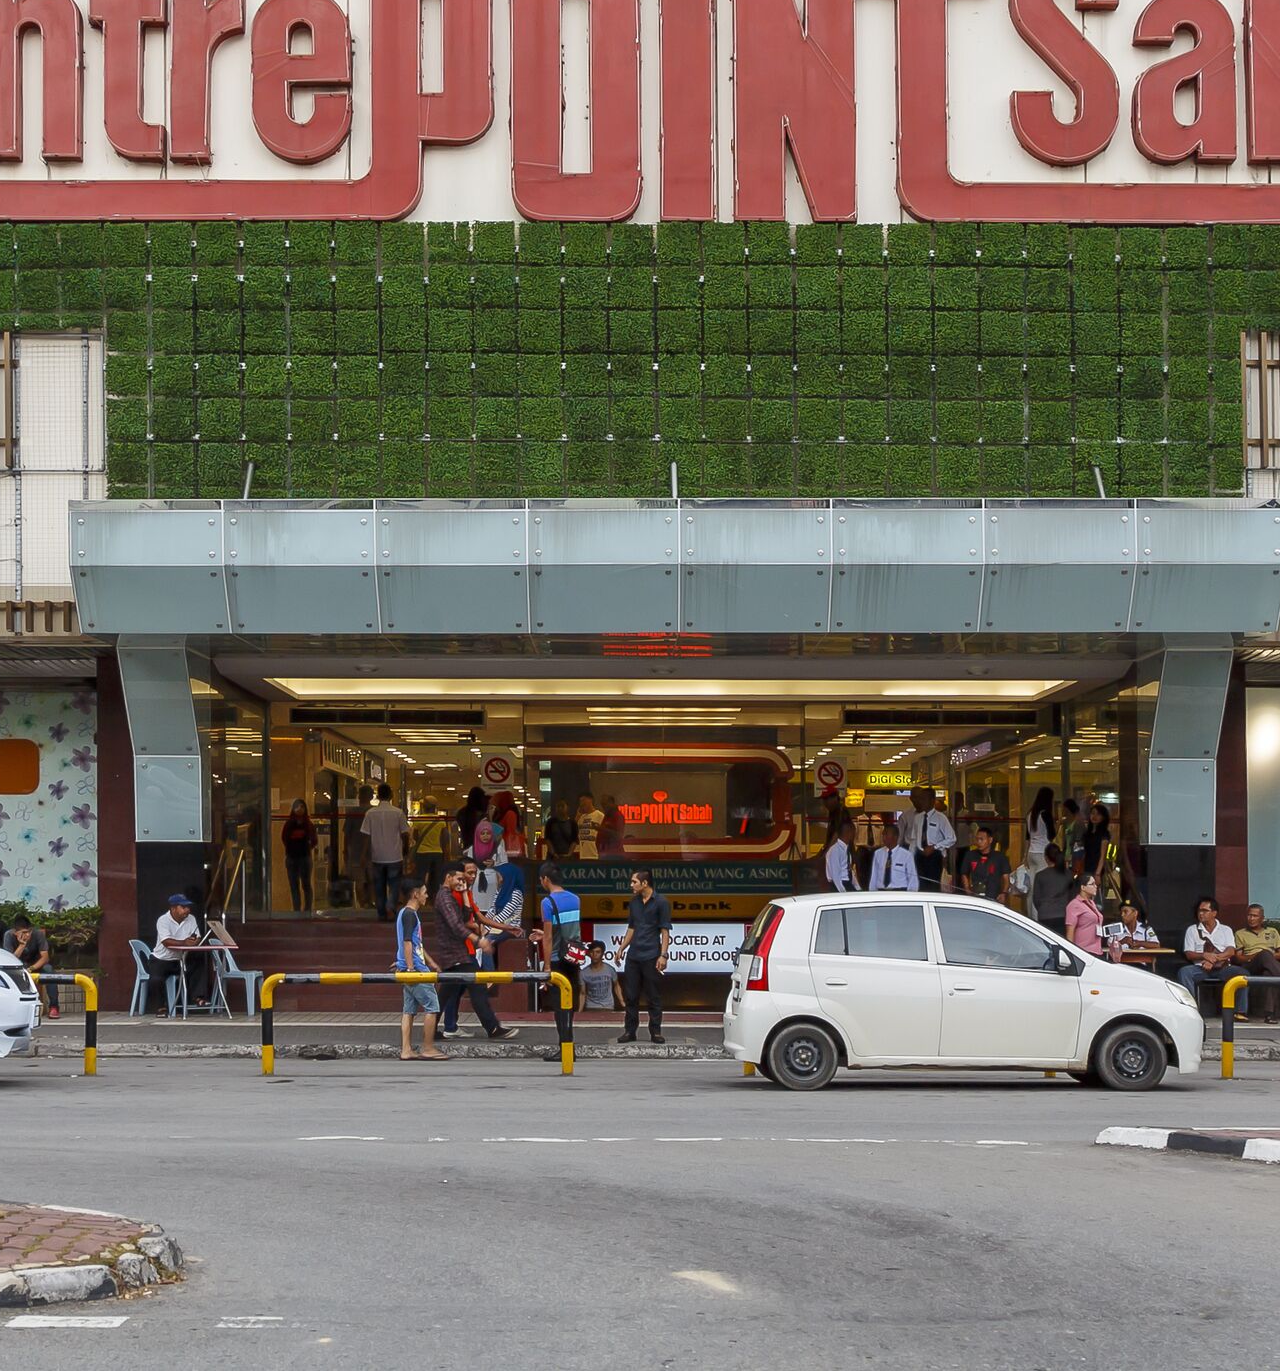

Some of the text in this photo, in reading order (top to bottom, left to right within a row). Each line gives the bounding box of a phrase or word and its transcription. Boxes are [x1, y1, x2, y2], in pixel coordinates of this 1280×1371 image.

[651, 867, 699, 879] IRIMAN
[704, 867, 745, 879] WANG
[749, 867, 789, 879] ASING
[670, 881, 714, 891] CHANGE
[712, 935, 727, 946] AT
